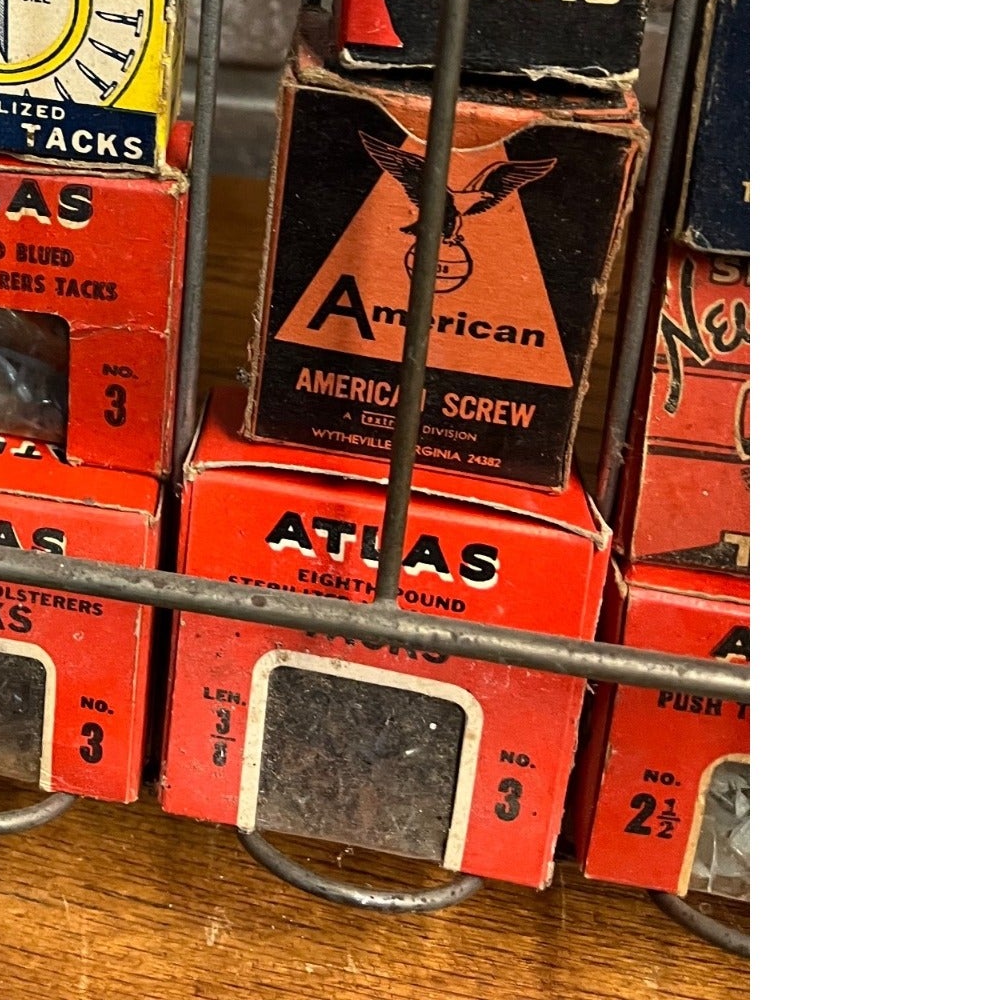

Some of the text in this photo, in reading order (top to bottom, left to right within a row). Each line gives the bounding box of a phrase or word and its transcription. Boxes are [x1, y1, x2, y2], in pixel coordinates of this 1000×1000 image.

[21, 122, 144, 160] TACKS
[15, 243, 75, 268] BLUED
[54, 277, 119, 301] TACKS
[307, 273, 546, 348] Amrican
[101, 363, 138, 380] NO.
[104, 384, 127, 427] 3
[442, 392, 537, 428] SCREW
[422, 425, 478, 442] DIVISION
[311, 428, 502, 468] WYTHEVILLE RGINIA 24382
[265, 511, 502, 590] ATLAS
[298, 568, 378, 596] EIGHTH
[80, 696, 114, 715] NO.
[203, 686, 247, 706] LEN.
[658, 690, 723, 716] PUSH
[79, 722, 104, 764] 3
[500, 749, 536, 769] NO.
[643, 768, 681, 787] NO.
[495, 777, 523, 822] 3
